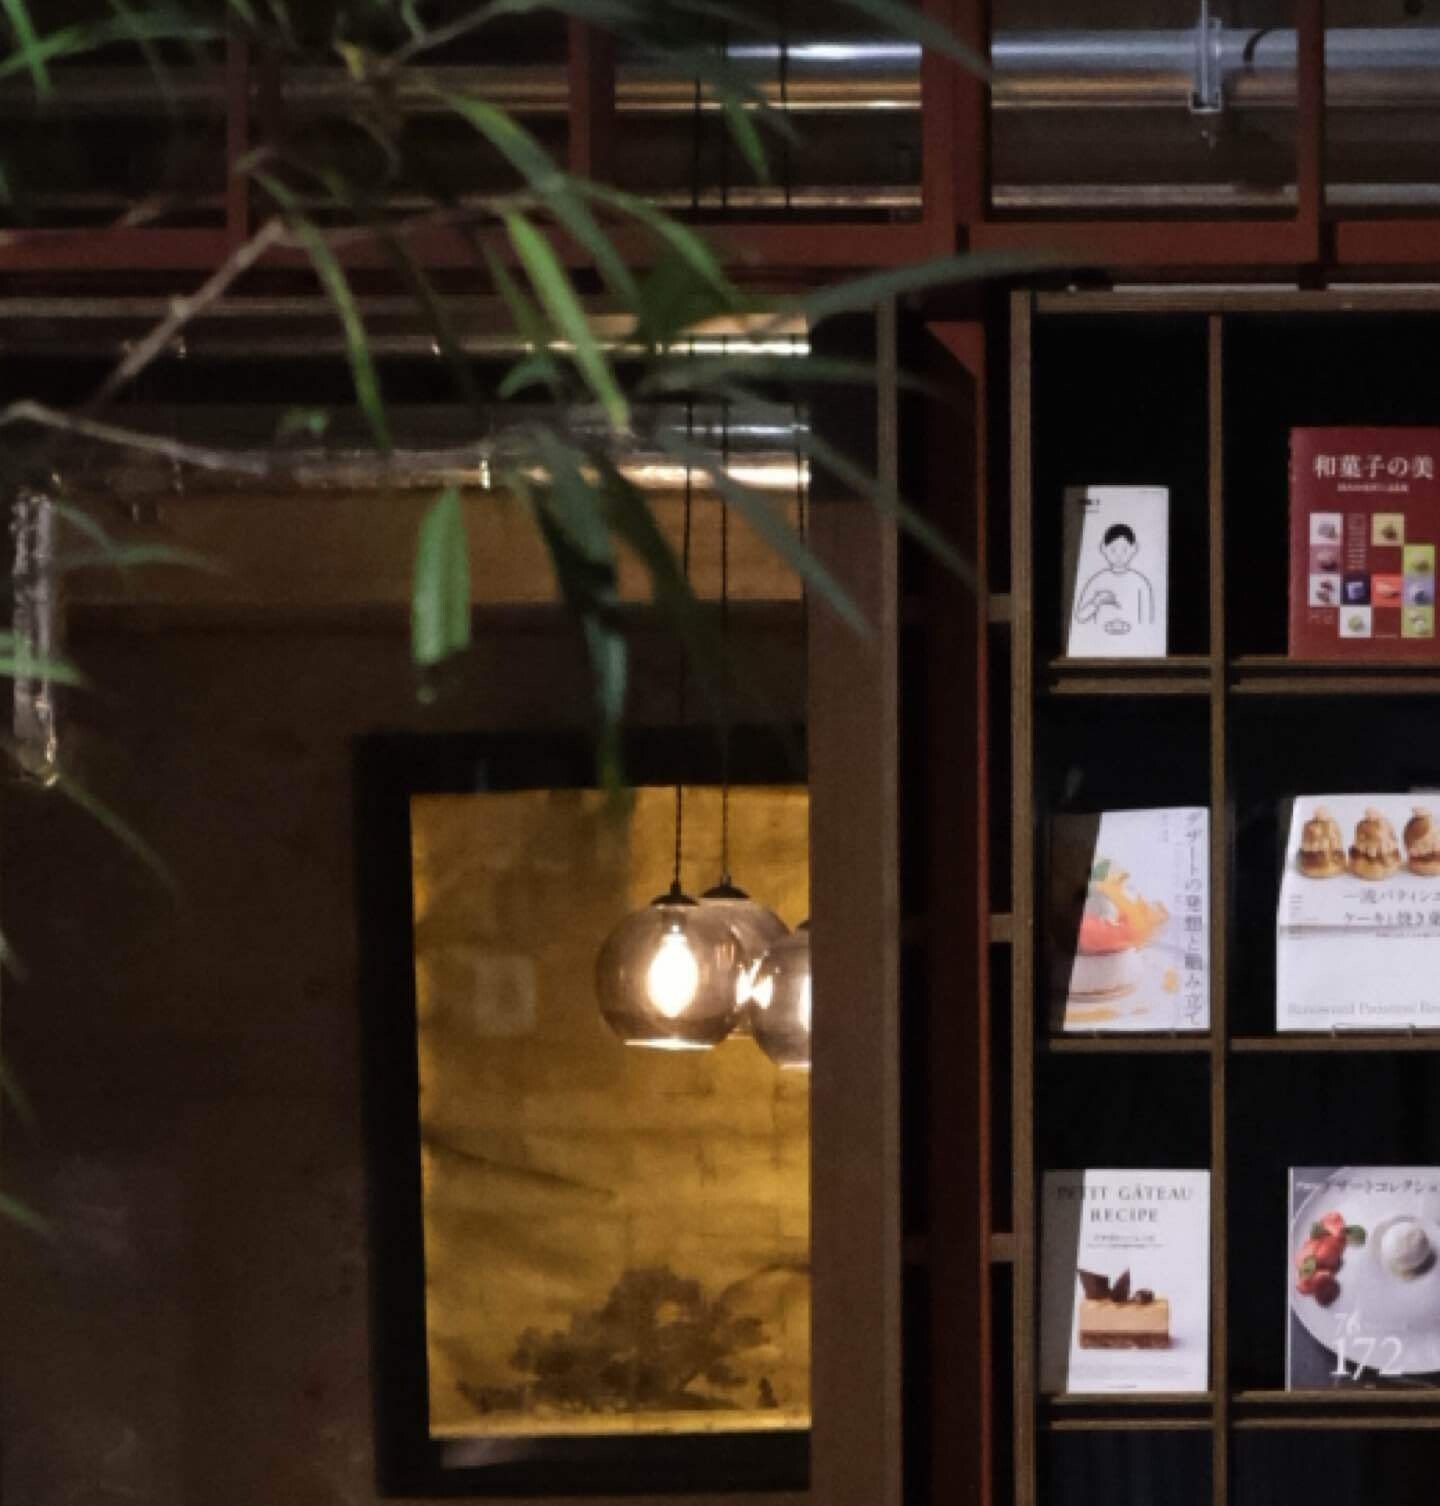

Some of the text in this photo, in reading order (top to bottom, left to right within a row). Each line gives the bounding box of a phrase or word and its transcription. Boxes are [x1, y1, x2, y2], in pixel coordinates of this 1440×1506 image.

[1313, 454, 1435, 480] 和菓子の美
[1118, 1182, 1193, 1201] GÂTEAU
[1090, 1207, 1159, 1223] RECIPE
[1330, 1336, 1403, 1380] 172
